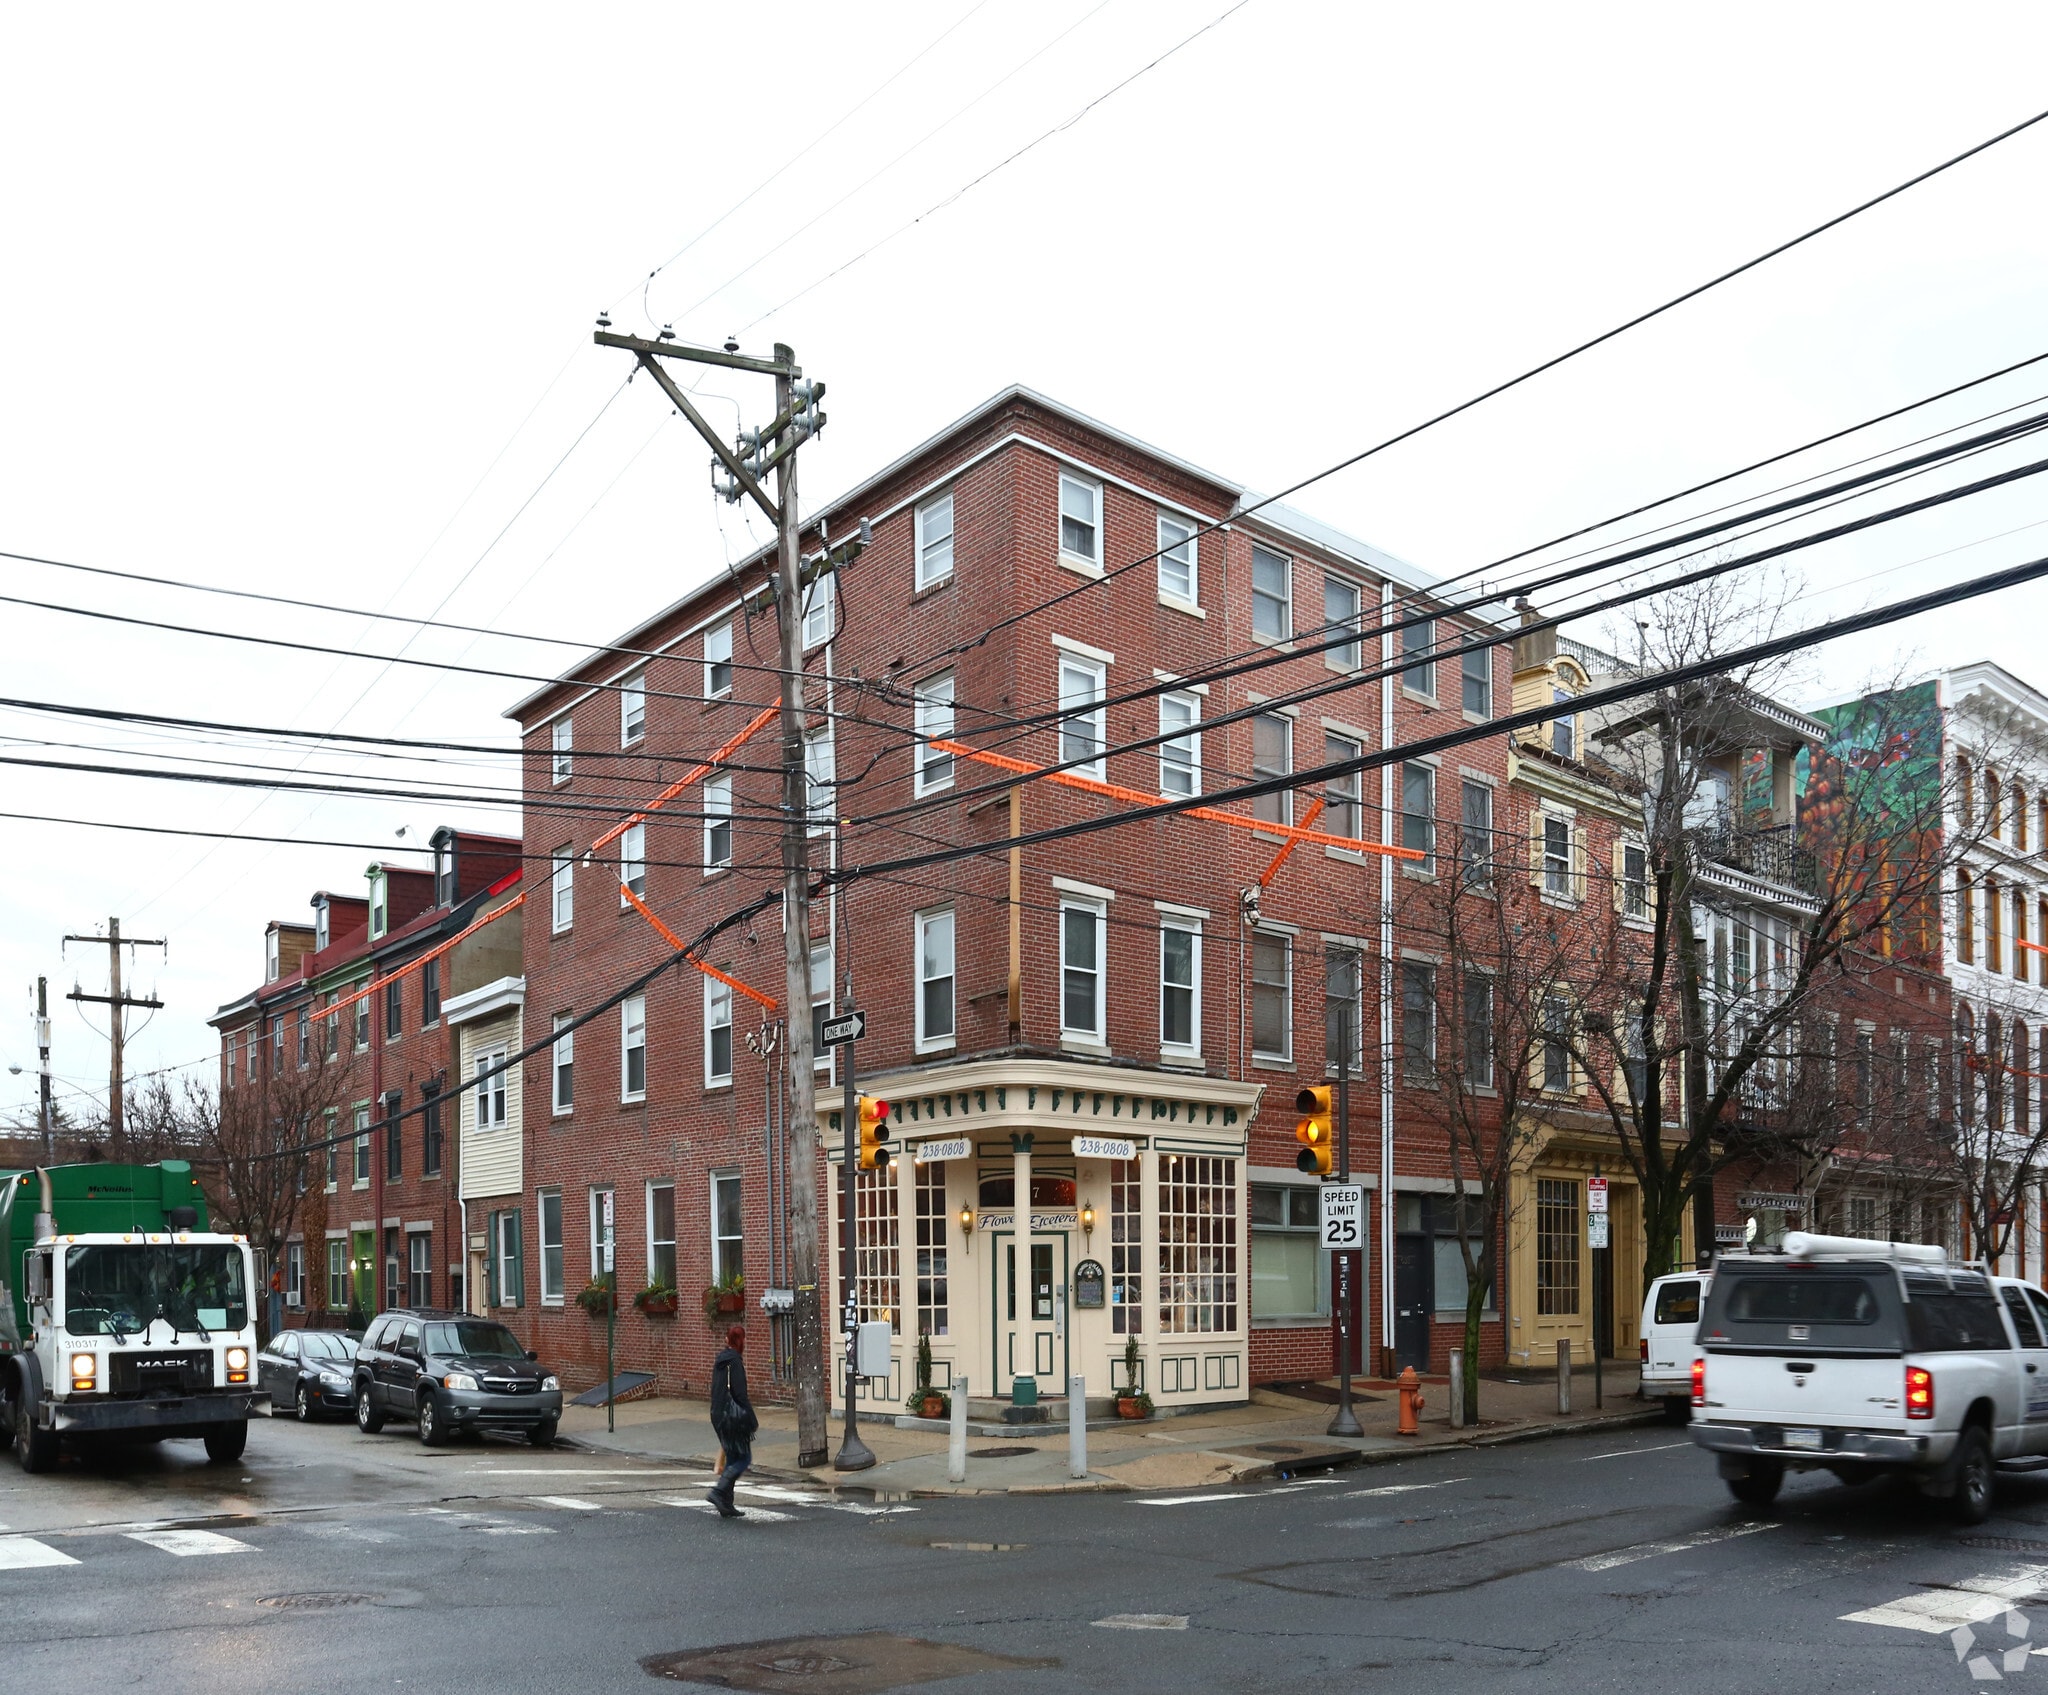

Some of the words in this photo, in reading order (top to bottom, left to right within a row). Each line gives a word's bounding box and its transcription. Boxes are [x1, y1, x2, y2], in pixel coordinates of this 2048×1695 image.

[826, 1027, 838, 1039] ONE
[840, 1022, 852, 1035] WAY
[1033, 1187, 1039, 1198] 7
[1324, 1191, 1358, 1202] SPEED
[1327, 1205, 1355, 1216] LIMIT
[1327, 1220, 1357, 1242] 25
[65, 1339, 98, 1348] 310317
[136, 1359, 188, 1368] MACK
